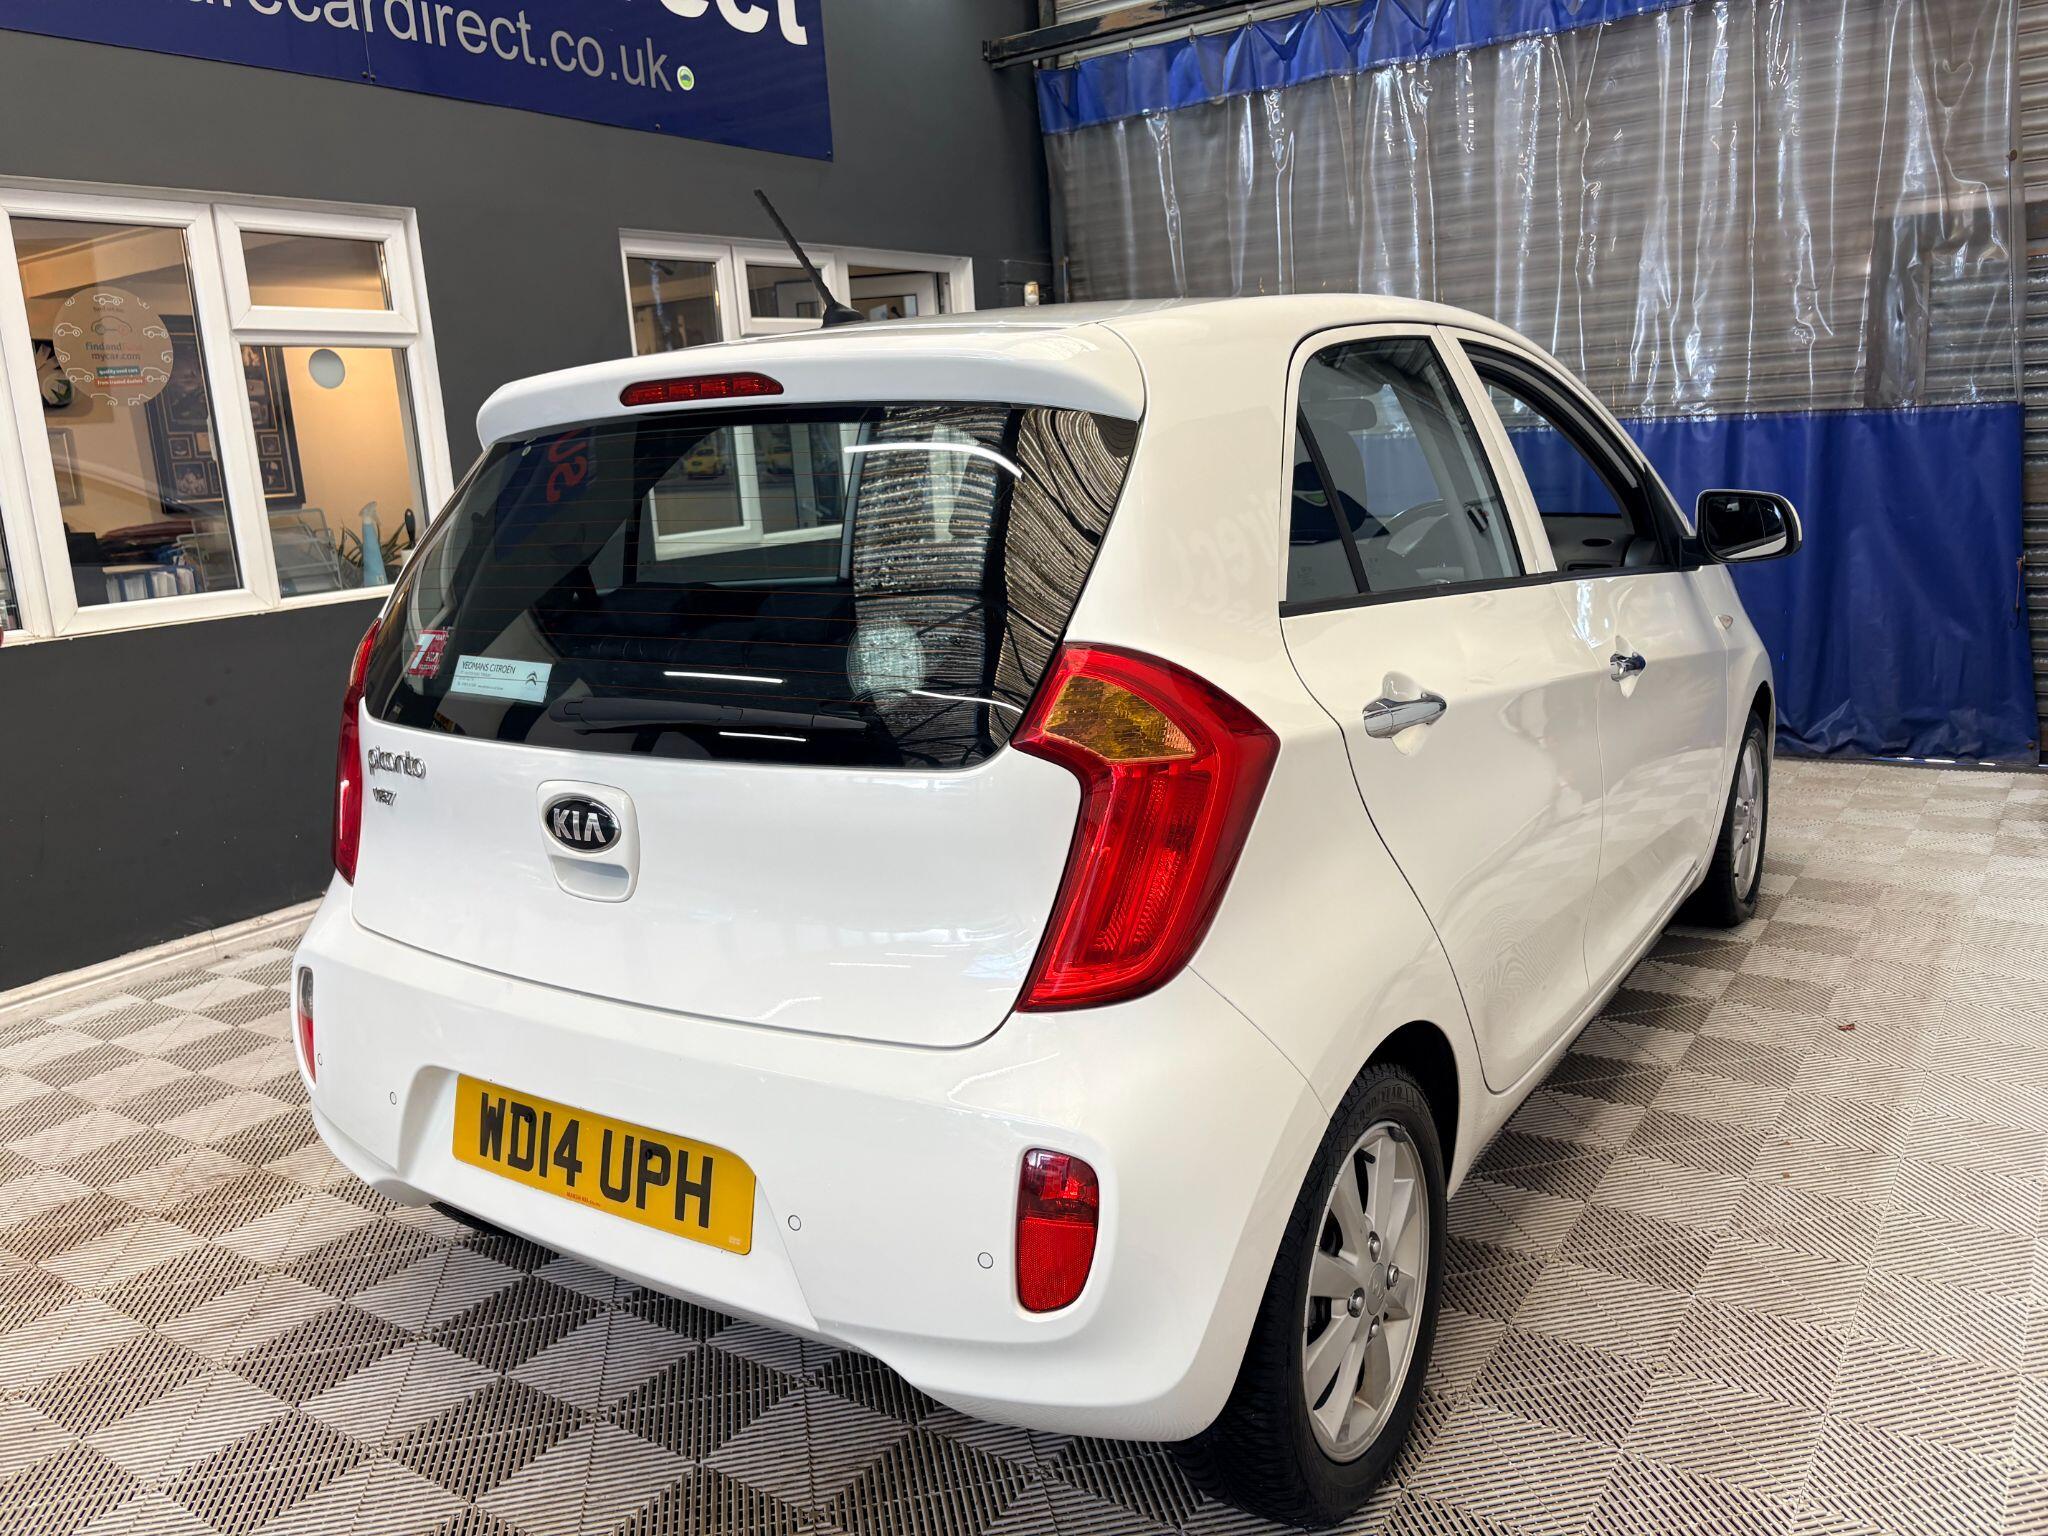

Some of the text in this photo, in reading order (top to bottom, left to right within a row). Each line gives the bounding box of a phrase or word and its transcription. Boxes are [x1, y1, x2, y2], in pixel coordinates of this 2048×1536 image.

[462, 660, 489, 673] YEOMANS
[490, 663, 517, 675] CITROËN
[368, 745, 426, 779] picanto
[553, 808, 606, 842] KIA
[479, 1092, 713, 1228] WD14 UPH
